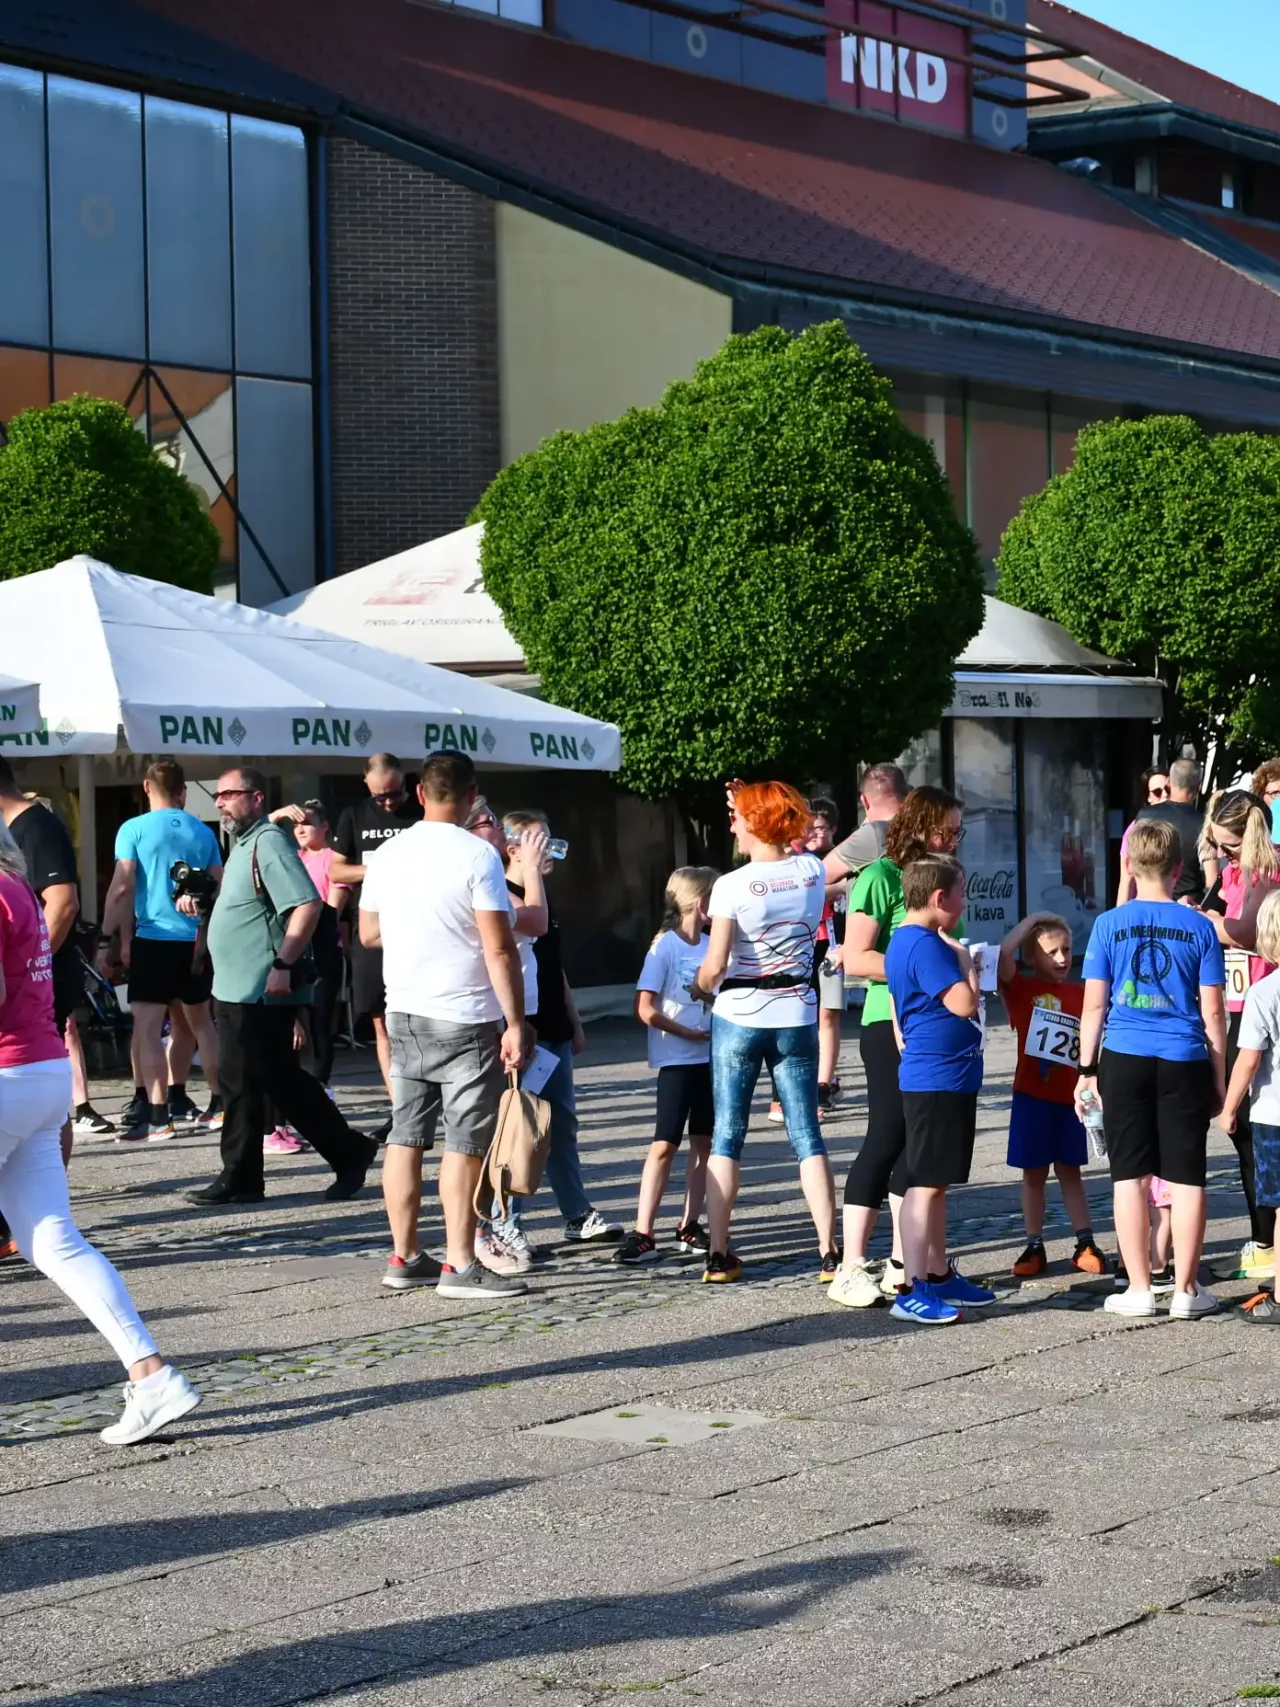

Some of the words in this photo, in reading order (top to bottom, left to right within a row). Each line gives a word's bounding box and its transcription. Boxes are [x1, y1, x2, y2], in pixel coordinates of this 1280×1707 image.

[841, 34, 947, 103] NKD
[160, 715, 224, 745] PAN
[292, 718, 351, 747] PAN
[425, 723, 479, 751] PAN
[530, 732, 580, 761] PAN
[361, 828, 402, 840] PELOT
[967, 904, 971, 922] i
[974, 904, 1005, 921] kava
[1035, 1026, 1080, 1061] 128
